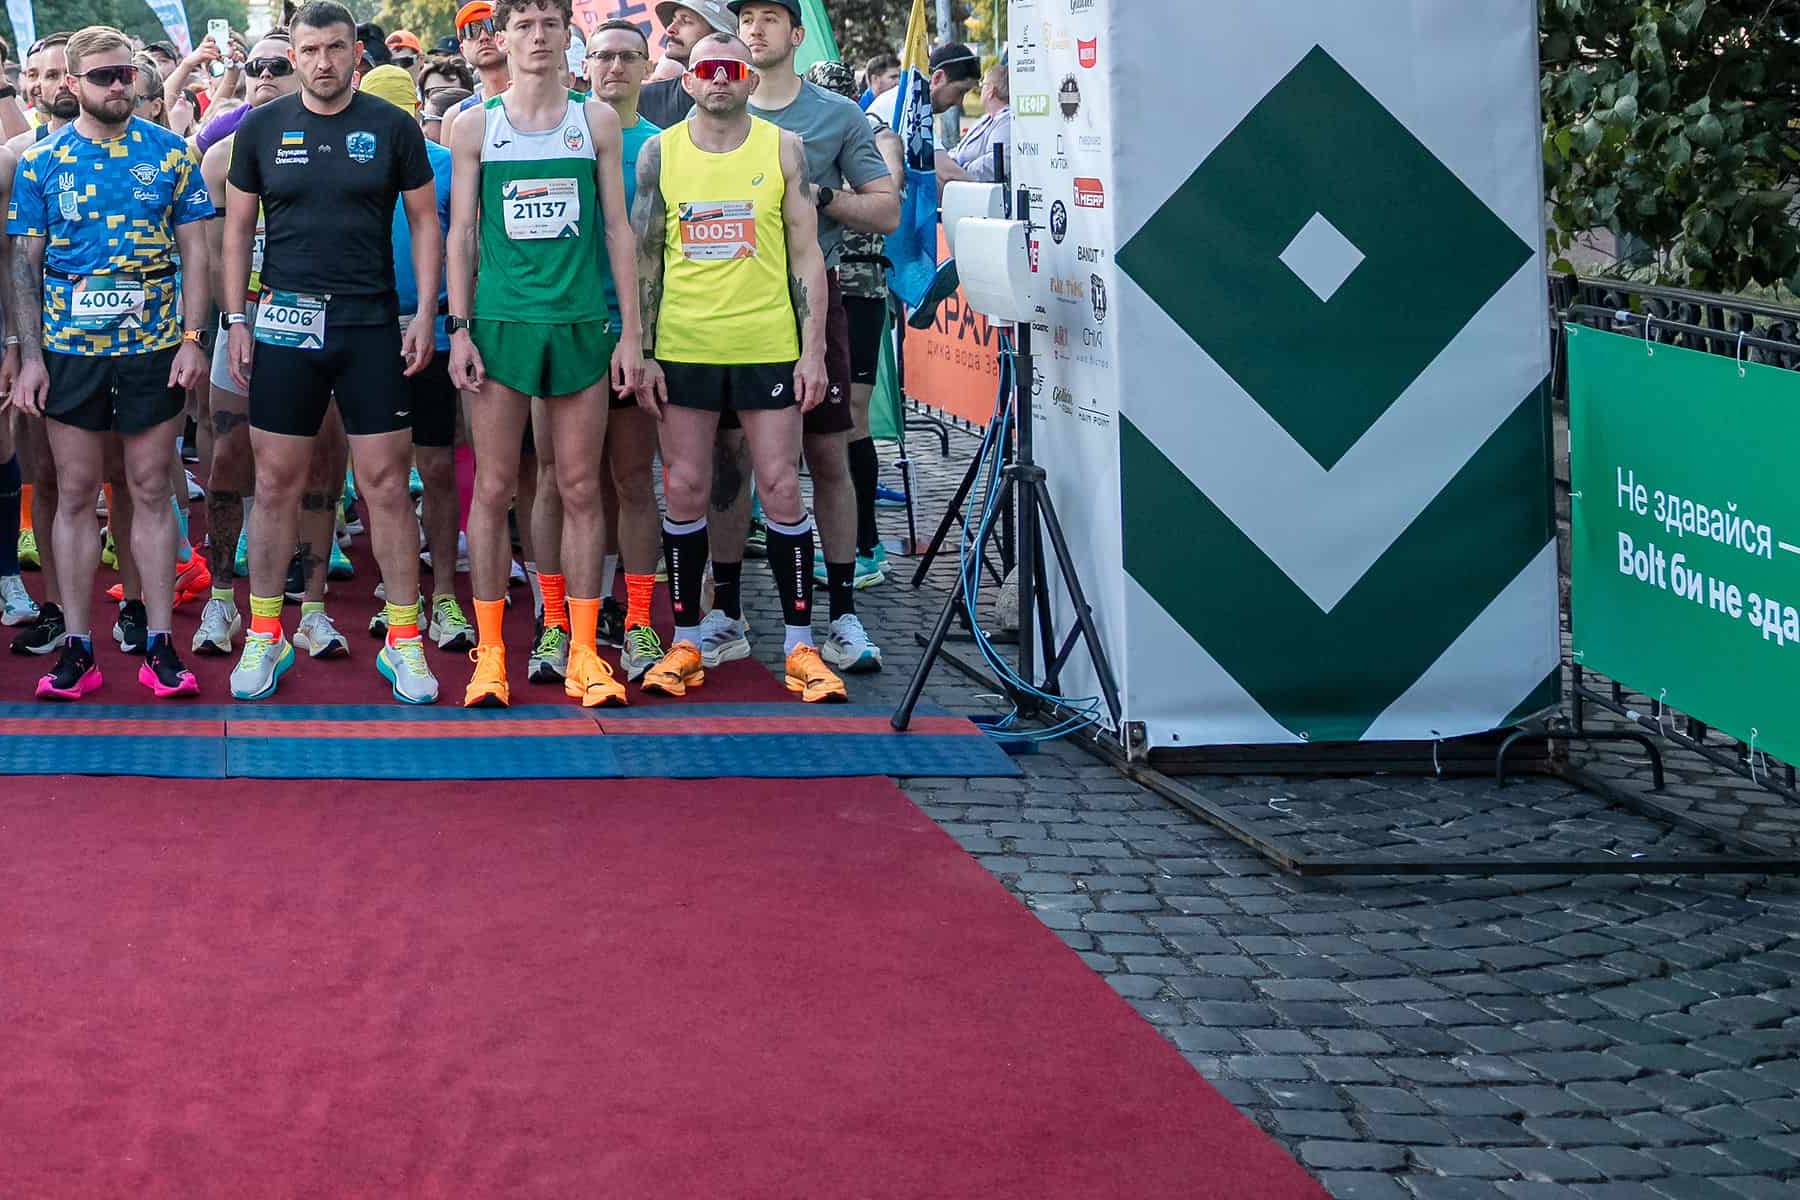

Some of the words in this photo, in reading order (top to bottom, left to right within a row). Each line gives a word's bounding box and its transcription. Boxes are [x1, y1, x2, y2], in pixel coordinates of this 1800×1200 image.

[512, 201, 567, 220] 21137
[686, 222, 745, 240] 10051
[79, 292, 135, 309] 4004
[263, 306, 313, 327] 4006
[1616, 466, 1648, 517] Не
[1653, 488, 1772, 560] здавайся
[1618, 531, 1667, 590] Bolt
[1670, 554, 1703, 604] би
[1708, 576, 1742, 619] не
